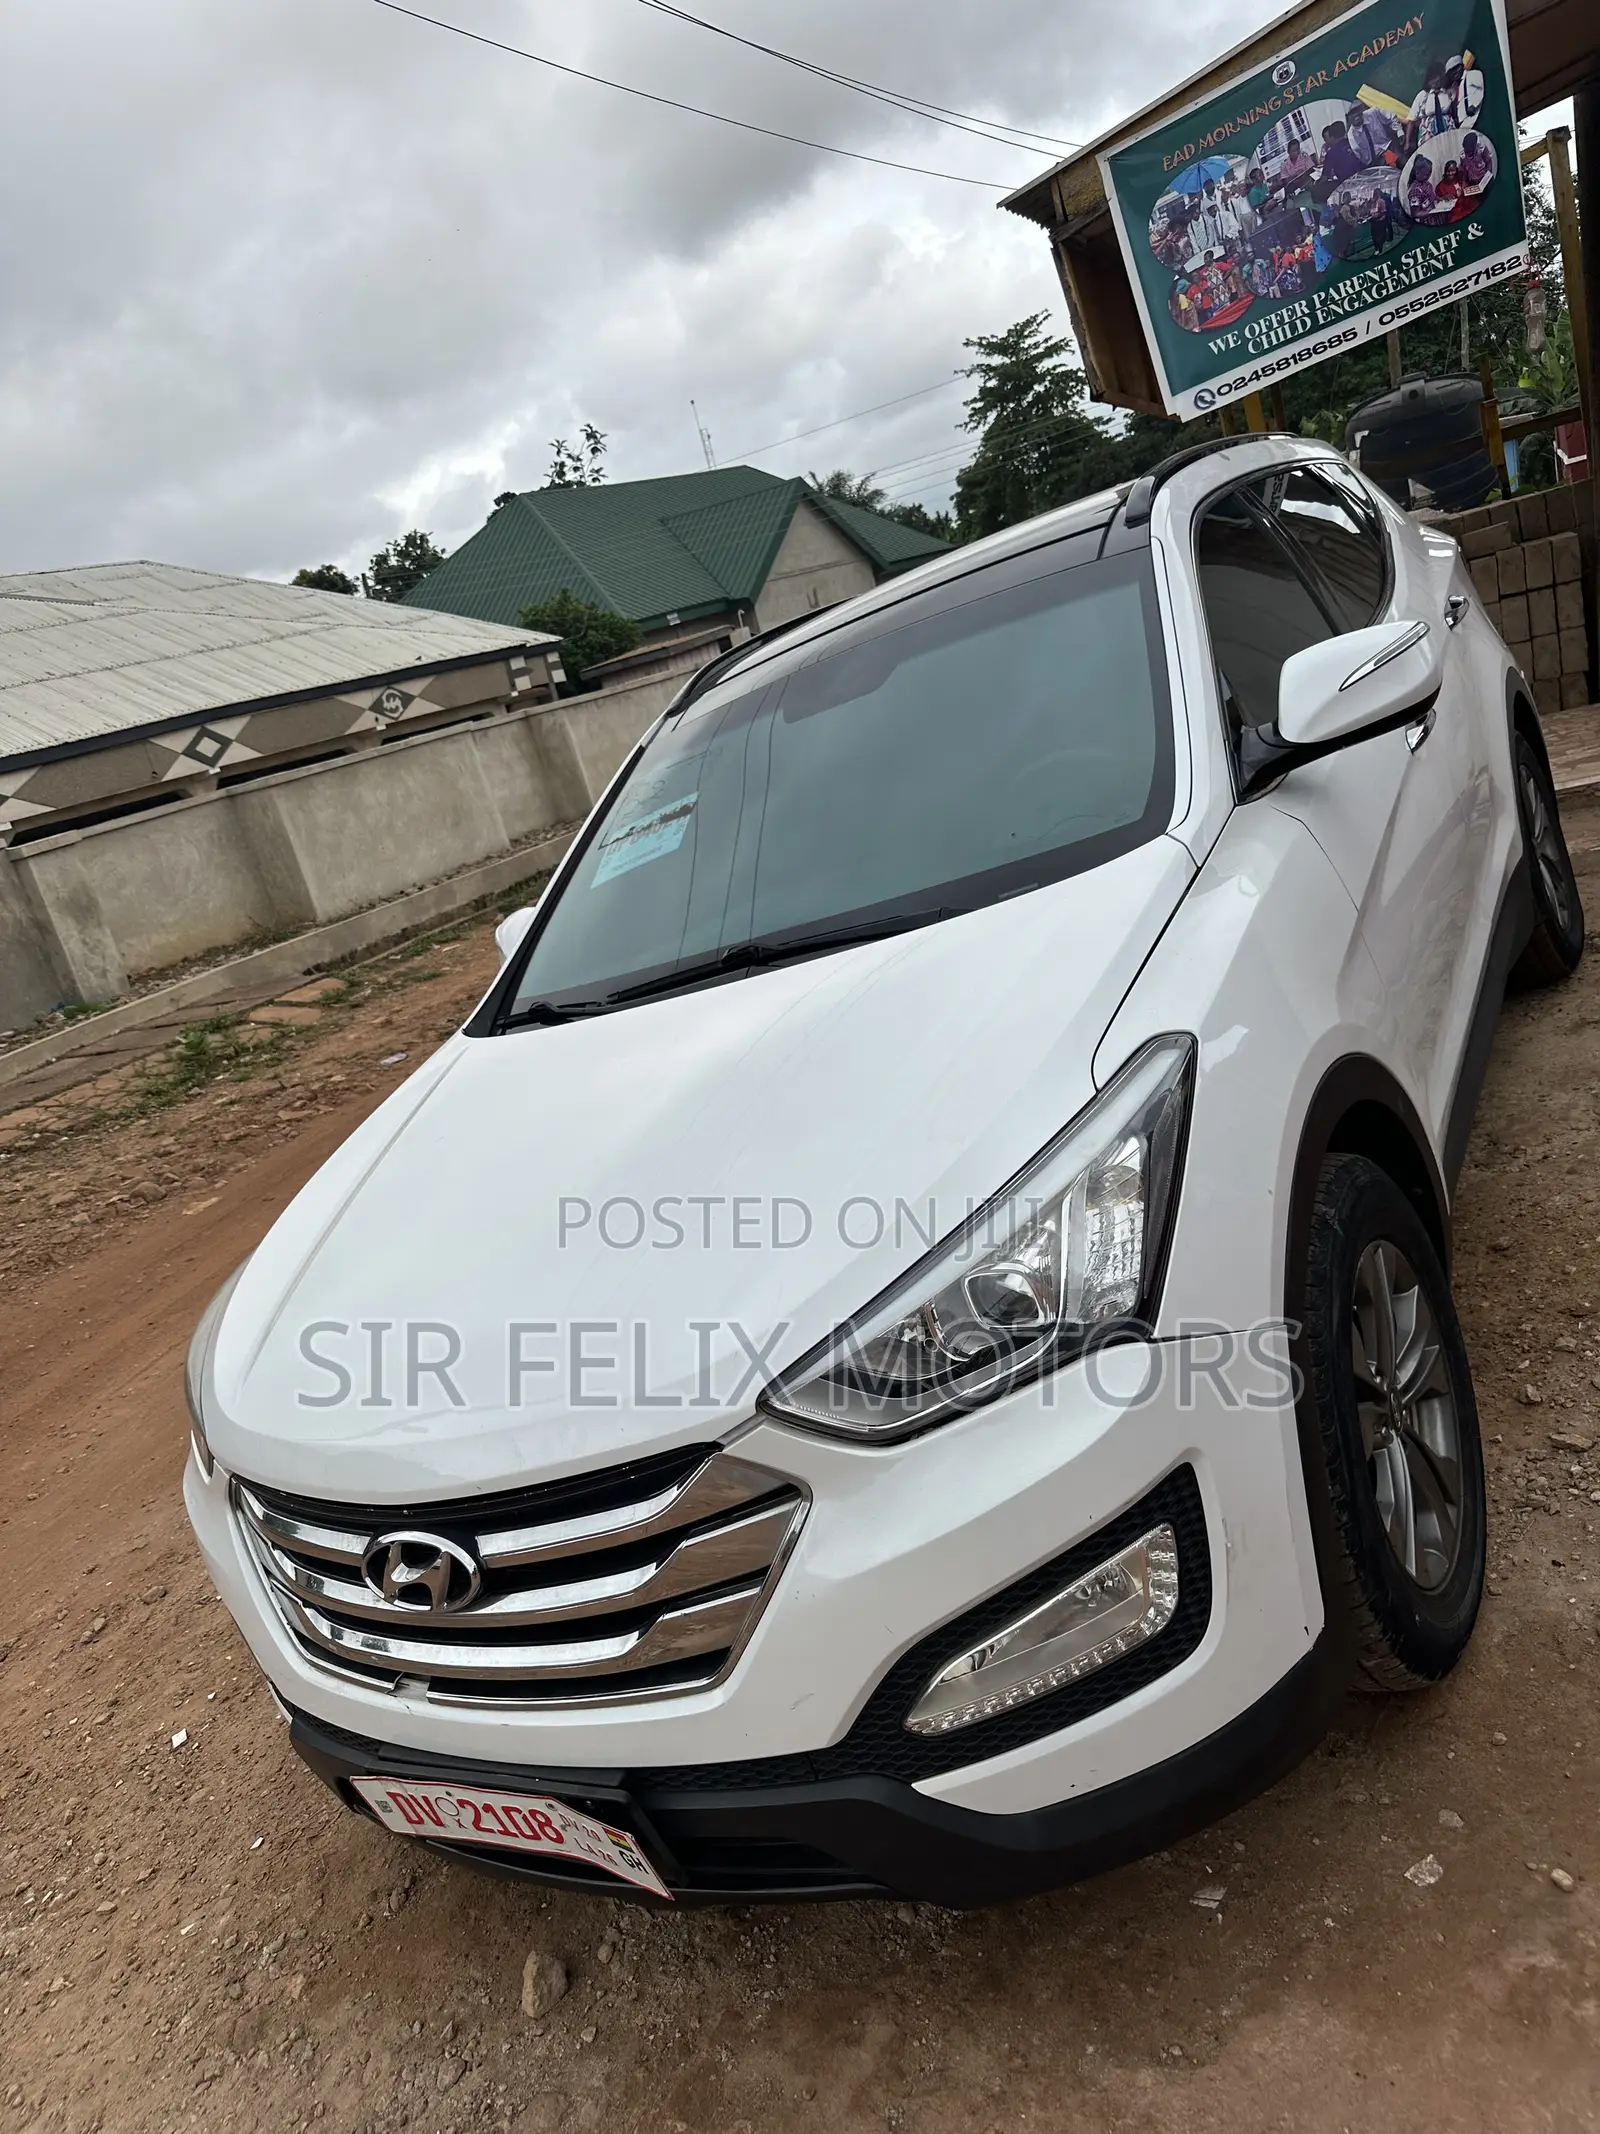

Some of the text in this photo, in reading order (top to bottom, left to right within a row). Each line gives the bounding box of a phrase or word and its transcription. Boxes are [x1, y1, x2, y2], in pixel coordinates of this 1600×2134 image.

[1199, 95, 1281, 153] MORNING
[1284, 70, 1331, 104] STAR
[1333, 12, 1425, 78] ACADEMY
[1208, 222, 1484, 355] WE OFFER PARENT, STAFF &
[1216, 327, 1358, 396] 0245818685
[1379, 255, 1522, 326] 0552527182
[1248, 250, 1455, 354] CHILD ENGAGEMENT
[386, 1791, 564, 1844] DV 2108
[619, 1850, 649, 1875] GH
